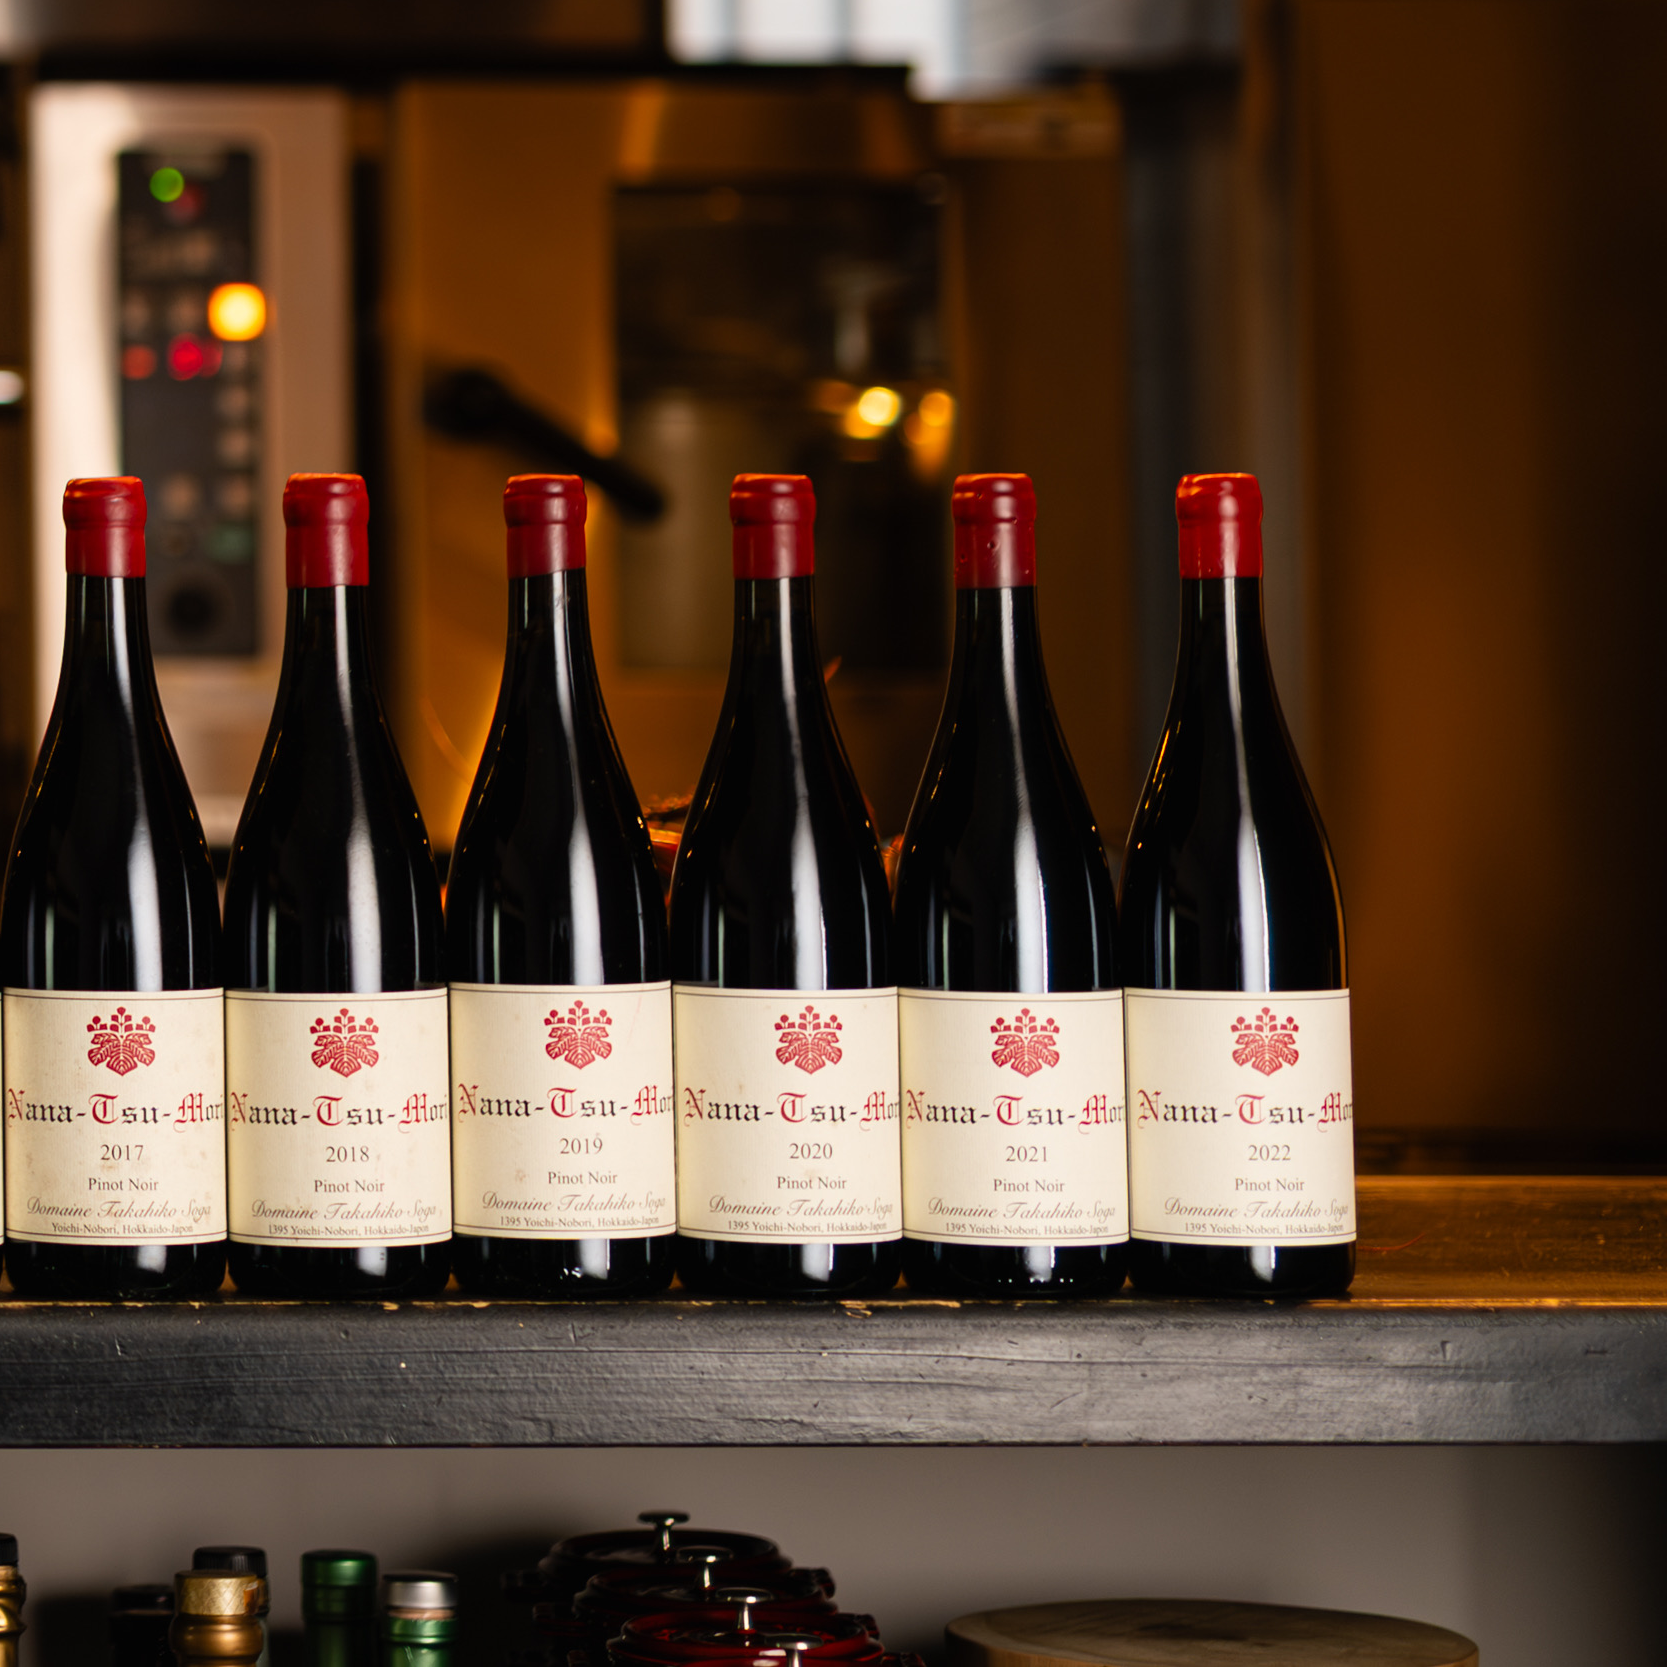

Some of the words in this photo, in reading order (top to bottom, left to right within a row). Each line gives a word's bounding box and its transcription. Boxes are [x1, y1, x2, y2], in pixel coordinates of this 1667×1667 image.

[100, 1144, 143, 1161] 2017
[326, 1146, 369, 1162] 2018
[560, 1138, 603, 1154] 2019
[789, 1143, 832, 1159] 2020
[1006, 1146, 1047, 1162] 2021
[1248, 1145, 1291, 1161] 2022
[88, 1178, 123, 1190] Pinot
[129, 1179, 159, 1190] Noir
[548, 1171, 583, 1184] Pinot
[589, 1171, 617, 1184] Noir
[777, 1176, 812, 1189] Pinot
[818, 1176, 847, 1189] Noir
[993, 1179, 1029, 1192] Pinot
[1035, 1180, 1065, 1192] Noir
[1235, 1178, 1270, 1191] Pinot
[1276, 1179, 1305, 1191] Noir
[314, 1180, 349, 1193] Pinot
[355, 1180, 385, 1193] Noir
[27, 1197, 92, 1217] Domaine
[97, 1201, 177, 1218] Takahiko
[182, 1199, 211, 1222] Soga
[251, 1199, 318, 1219] Domaine
[324, 1203, 403, 1220] Takahiko
[407, 1200, 437, 1222] Soga
[482, 1191, 552, 1211] Domaine
[557, 1194, 635, 1211] Takahiko
[639, 1191, 665, 1215] Soga
[709, 1195, 781, 1216] Domaine
[787, 1199, 863, 1216] Takahiko
[867, 1197, 893, 1220] Soga
[928, 1197, 998, 1218] Domaine
[1003, 1202, 1083, 1219] Takahiko
[1087, 1200, 1115, 1224] Soga
[1164, 1197, 1237, 1217] Domaine
[1244, 1200, 1321, 1218] Takahiko
[1324, 1198, 1348, 1222] Soga
[500, 1216, 521, 1226] 1395
[728, 1221, 749, 1230] 1395
[945, 1223, 966, 1232] 1395
[1185, 1223, 1206, 1232] 1395
[268, 1225, 288, 1234] 1395
